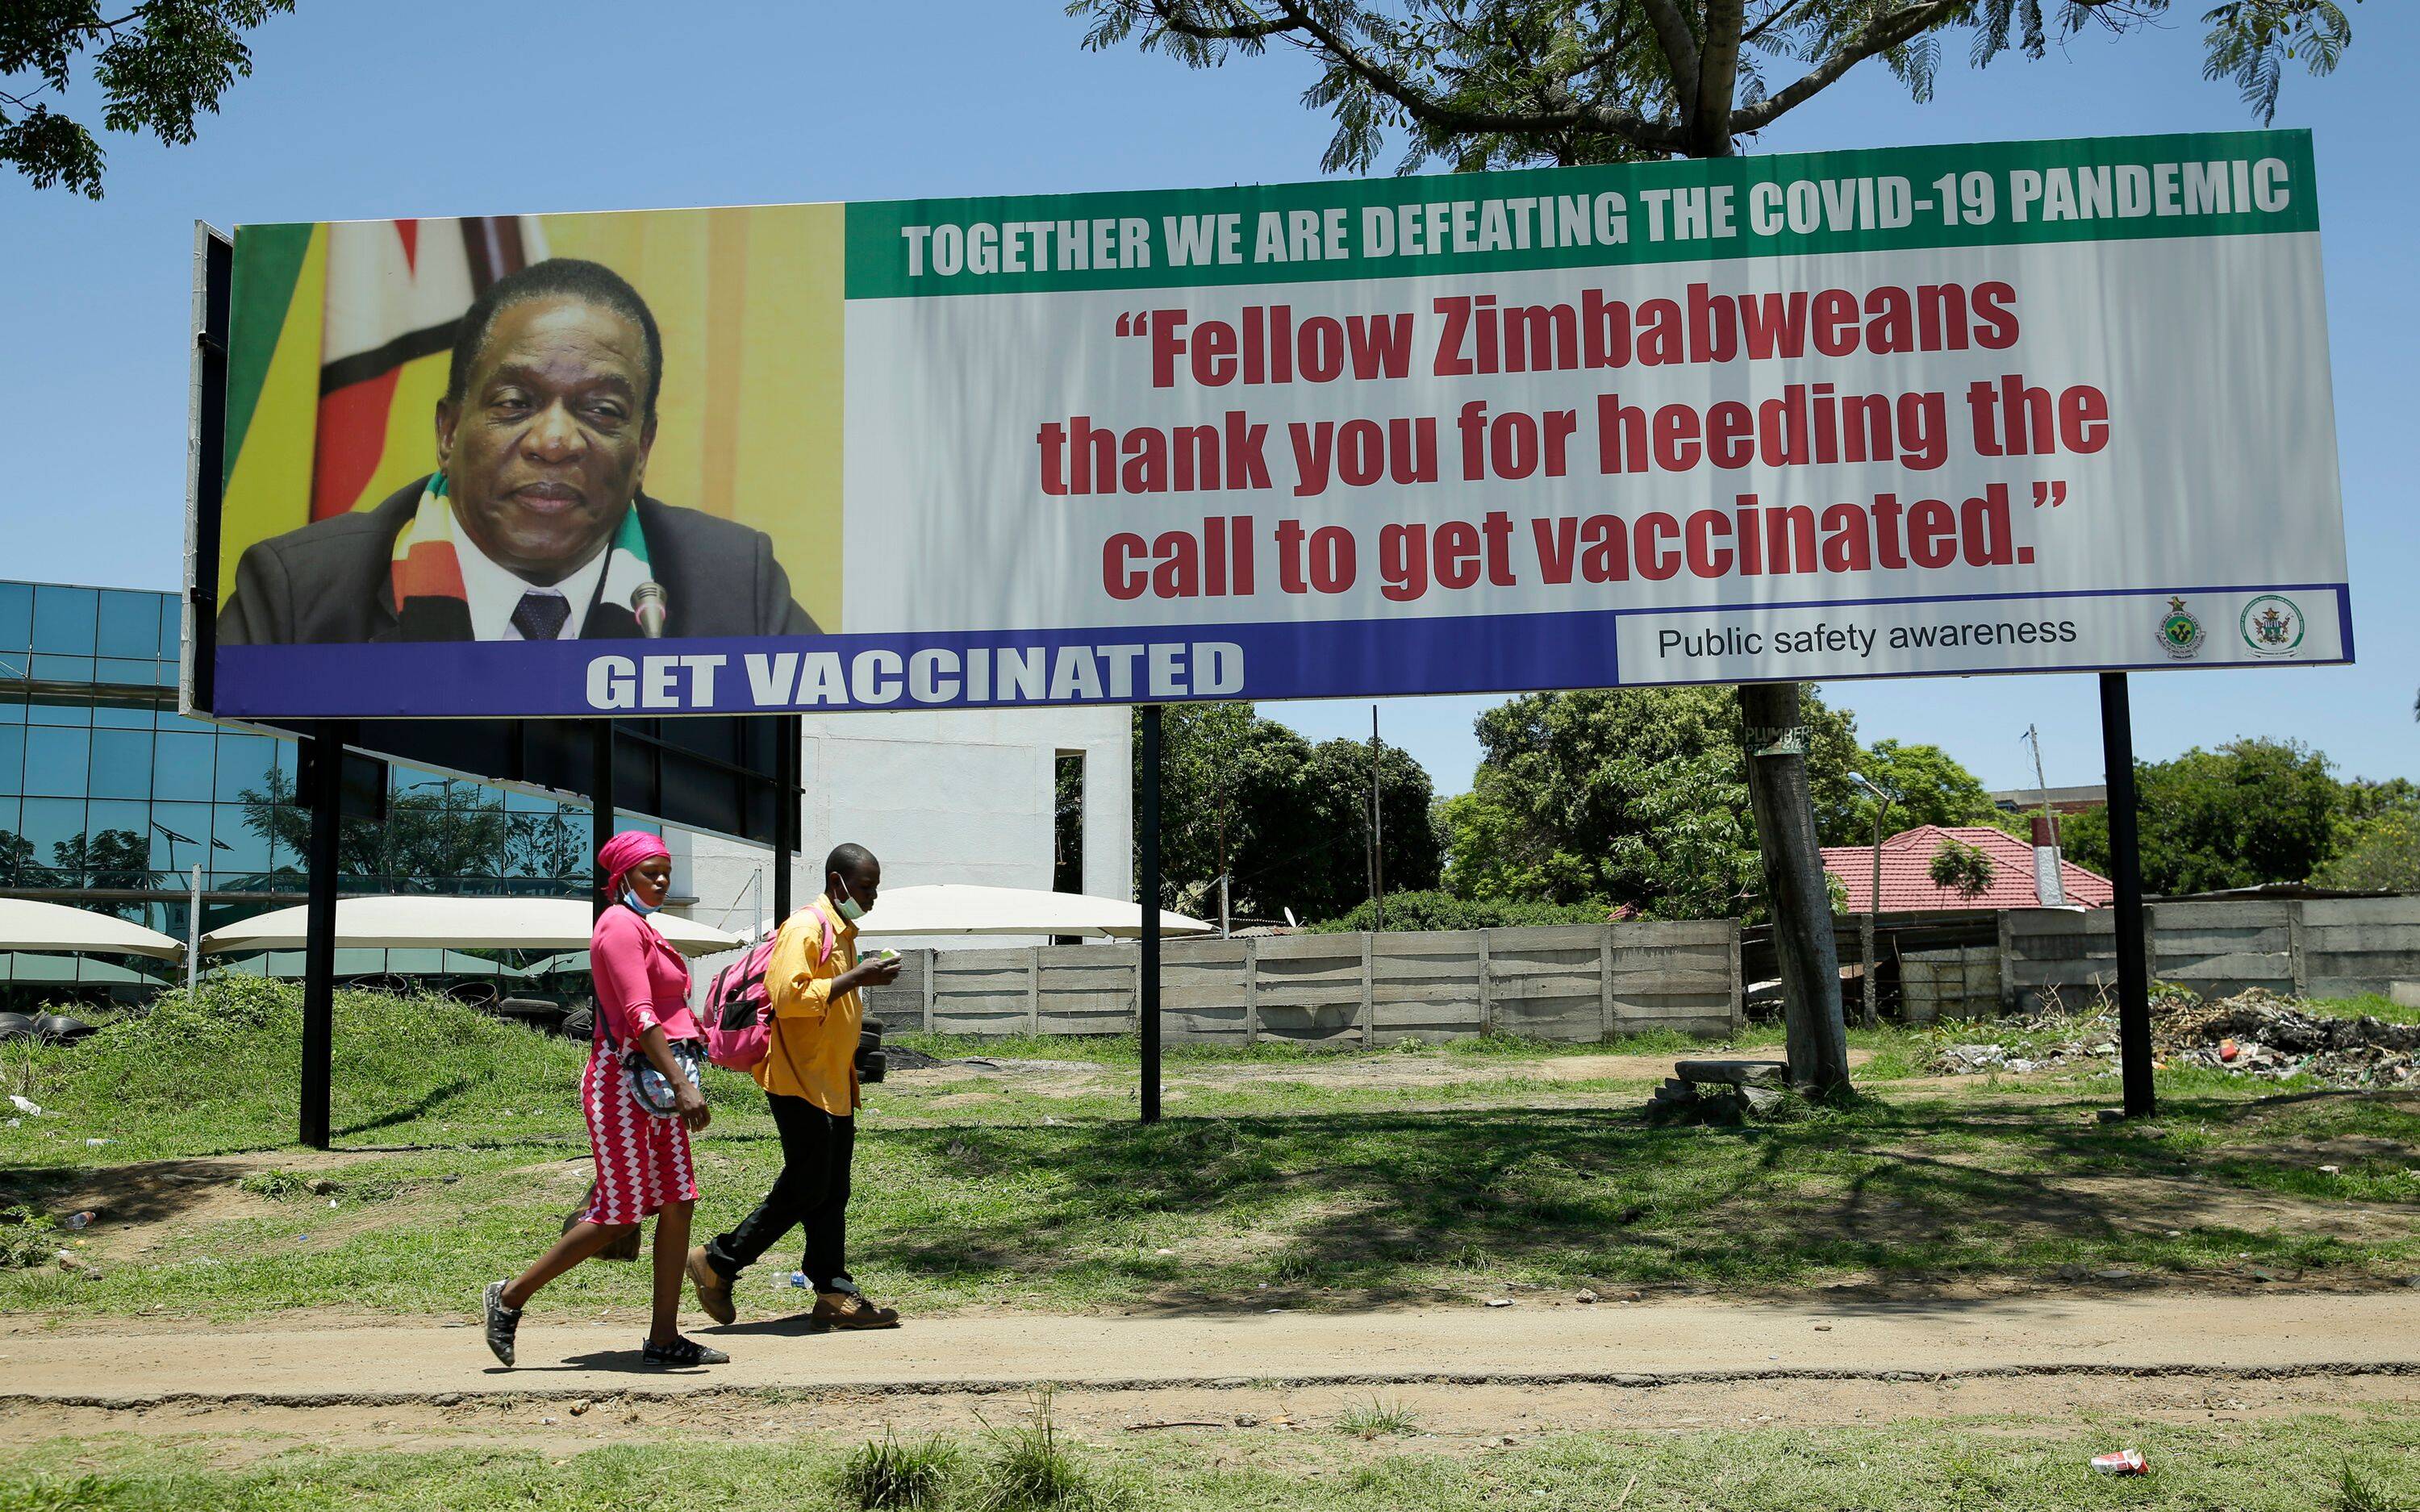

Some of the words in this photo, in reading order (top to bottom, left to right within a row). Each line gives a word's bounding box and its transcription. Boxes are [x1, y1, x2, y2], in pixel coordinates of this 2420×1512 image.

[901, 217, 1150, 277] TOGETHER
[1162, 213, 1243, 267] WE
[1254, 208, 1350, 264] ARE
[1362, 191, 1628, 258] DEFEATING
[1639, 185, 1737, 242] THE
[1749, 171, 1996, 236] COVID-19
[2009, 157, 2290, 223] PANDEMIC
[1433, 281, 2019, 377] Zimbabweans
[1037, 410, 1272, 496] thank
[1289, 417, 1437, 497] you
[1458, 400, 1576, 481] for
[1597, 383, 1949, 475] heeding
[1967, 374, 2109, 456] the
[1103, 516, 1254, 600] call
[1275, 519, 1357, 594] to
[1379, 511, 1517, 602] get
[585, 654, 727, 710] GET
[743, 642, 1245, 706] VACCINATED
[1659, 627, 1764, 658] Public
[1773, 622, 1878, 658] safety
[1888, 620, 2078, 649] awareness
[1745, 725, 1810, 743] PLUMBER
